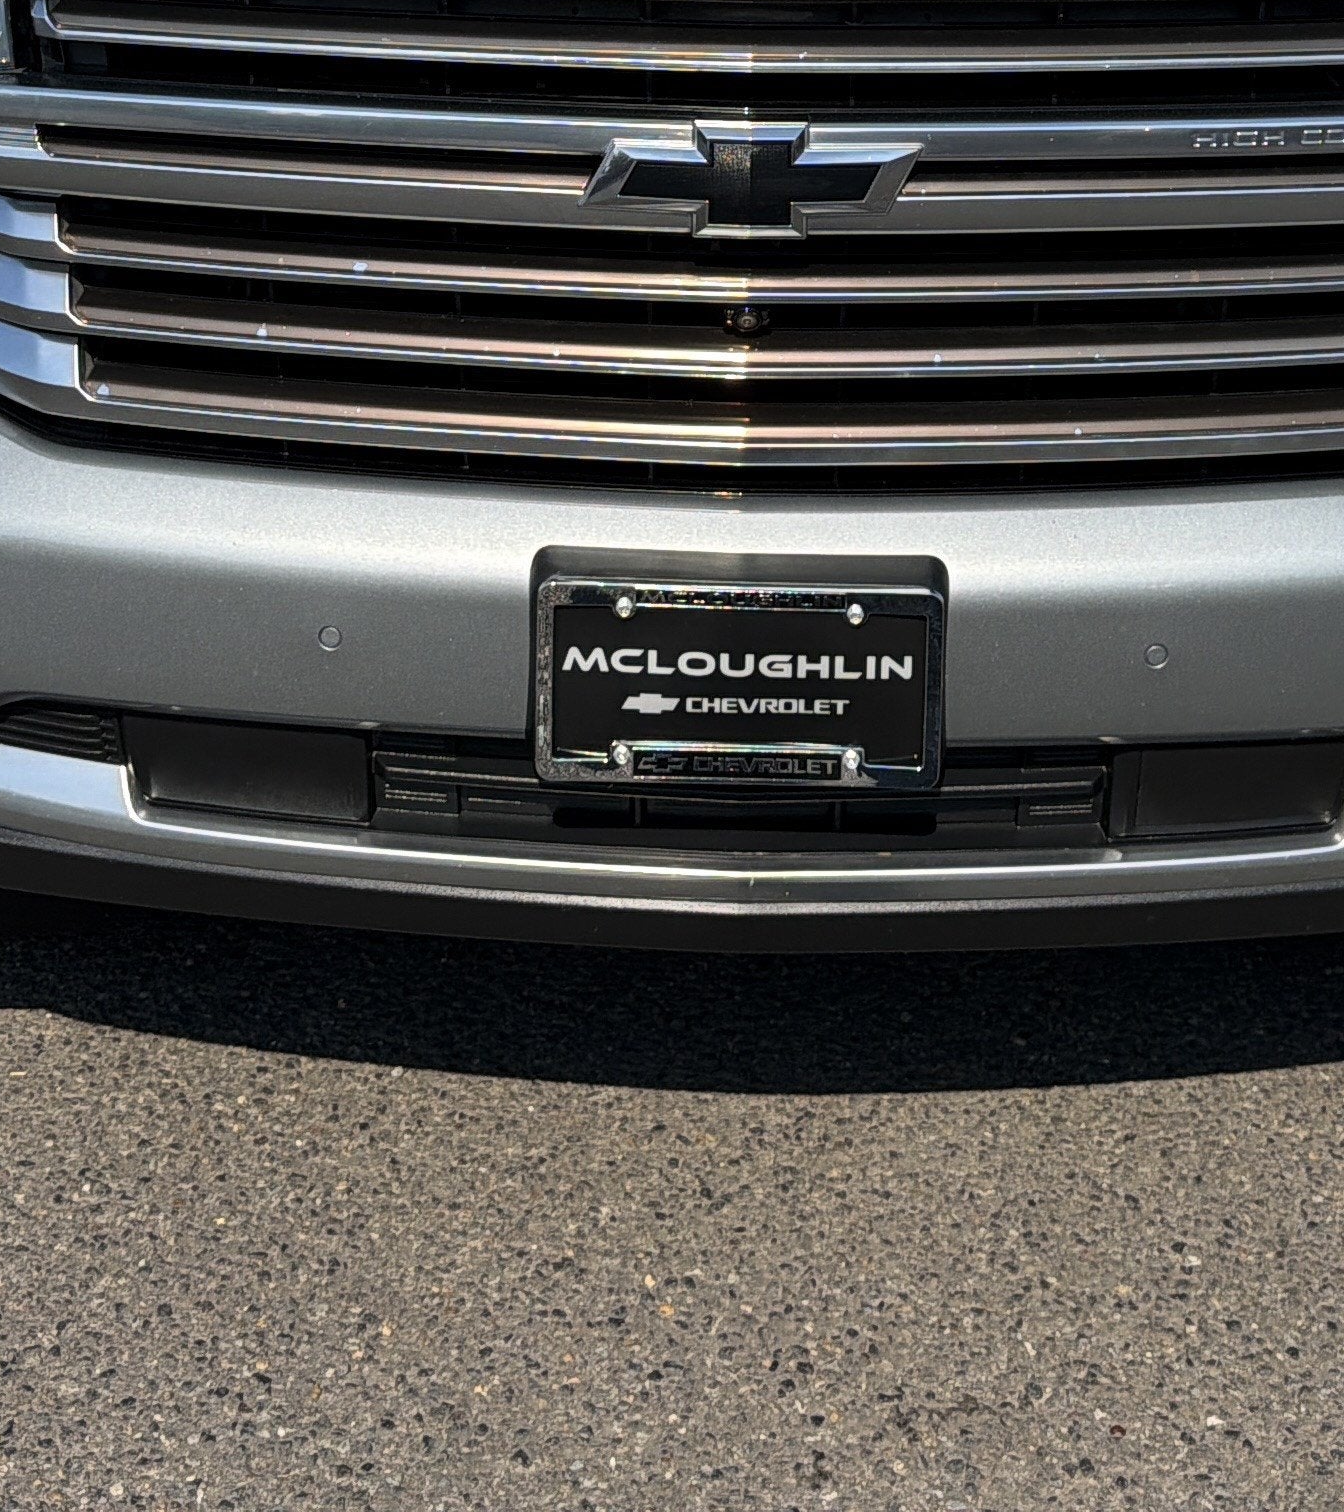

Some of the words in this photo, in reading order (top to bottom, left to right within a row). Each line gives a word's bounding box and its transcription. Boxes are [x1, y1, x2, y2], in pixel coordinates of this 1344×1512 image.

[1192, 130, 1286, 148] HIGH
[637, 591, 843, 607] MCLOUGHLIN
[562, 646, 913, 680] MCLOUGHLIN
[686, 697, 850, 715] CHEVROLET
[693, 756, 838, 775] CHEVROLET
